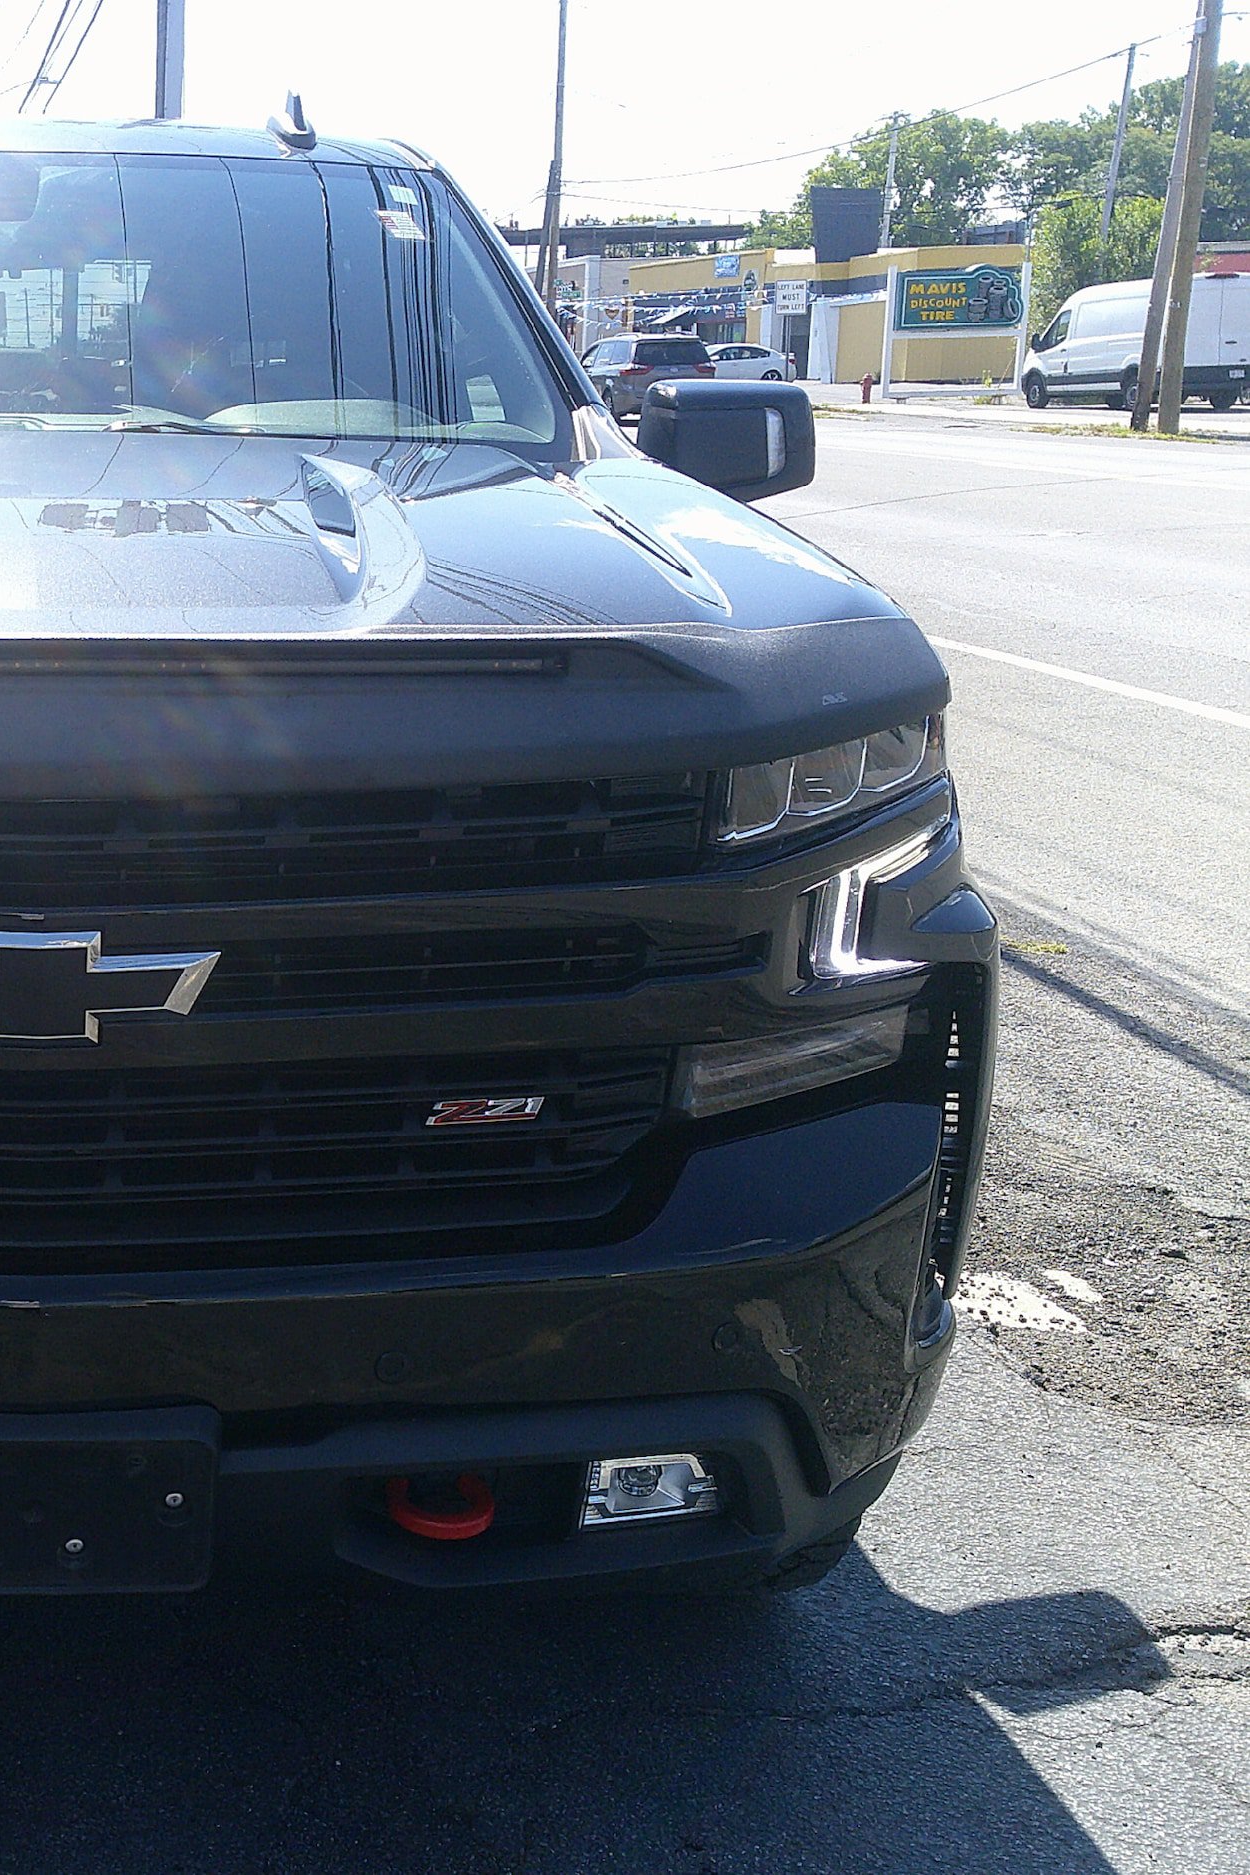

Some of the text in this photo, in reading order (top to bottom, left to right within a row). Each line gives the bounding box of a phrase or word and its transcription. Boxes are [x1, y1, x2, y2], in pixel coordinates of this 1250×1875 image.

[910, 282, 967, 295] MAVIS
[782, 293, 800, 301] MUST
[910, 296, 968, 309] DISCOUNT
[920, 310, 955, 321] TIRE
[425, 1096, 545, 1126] Z71
